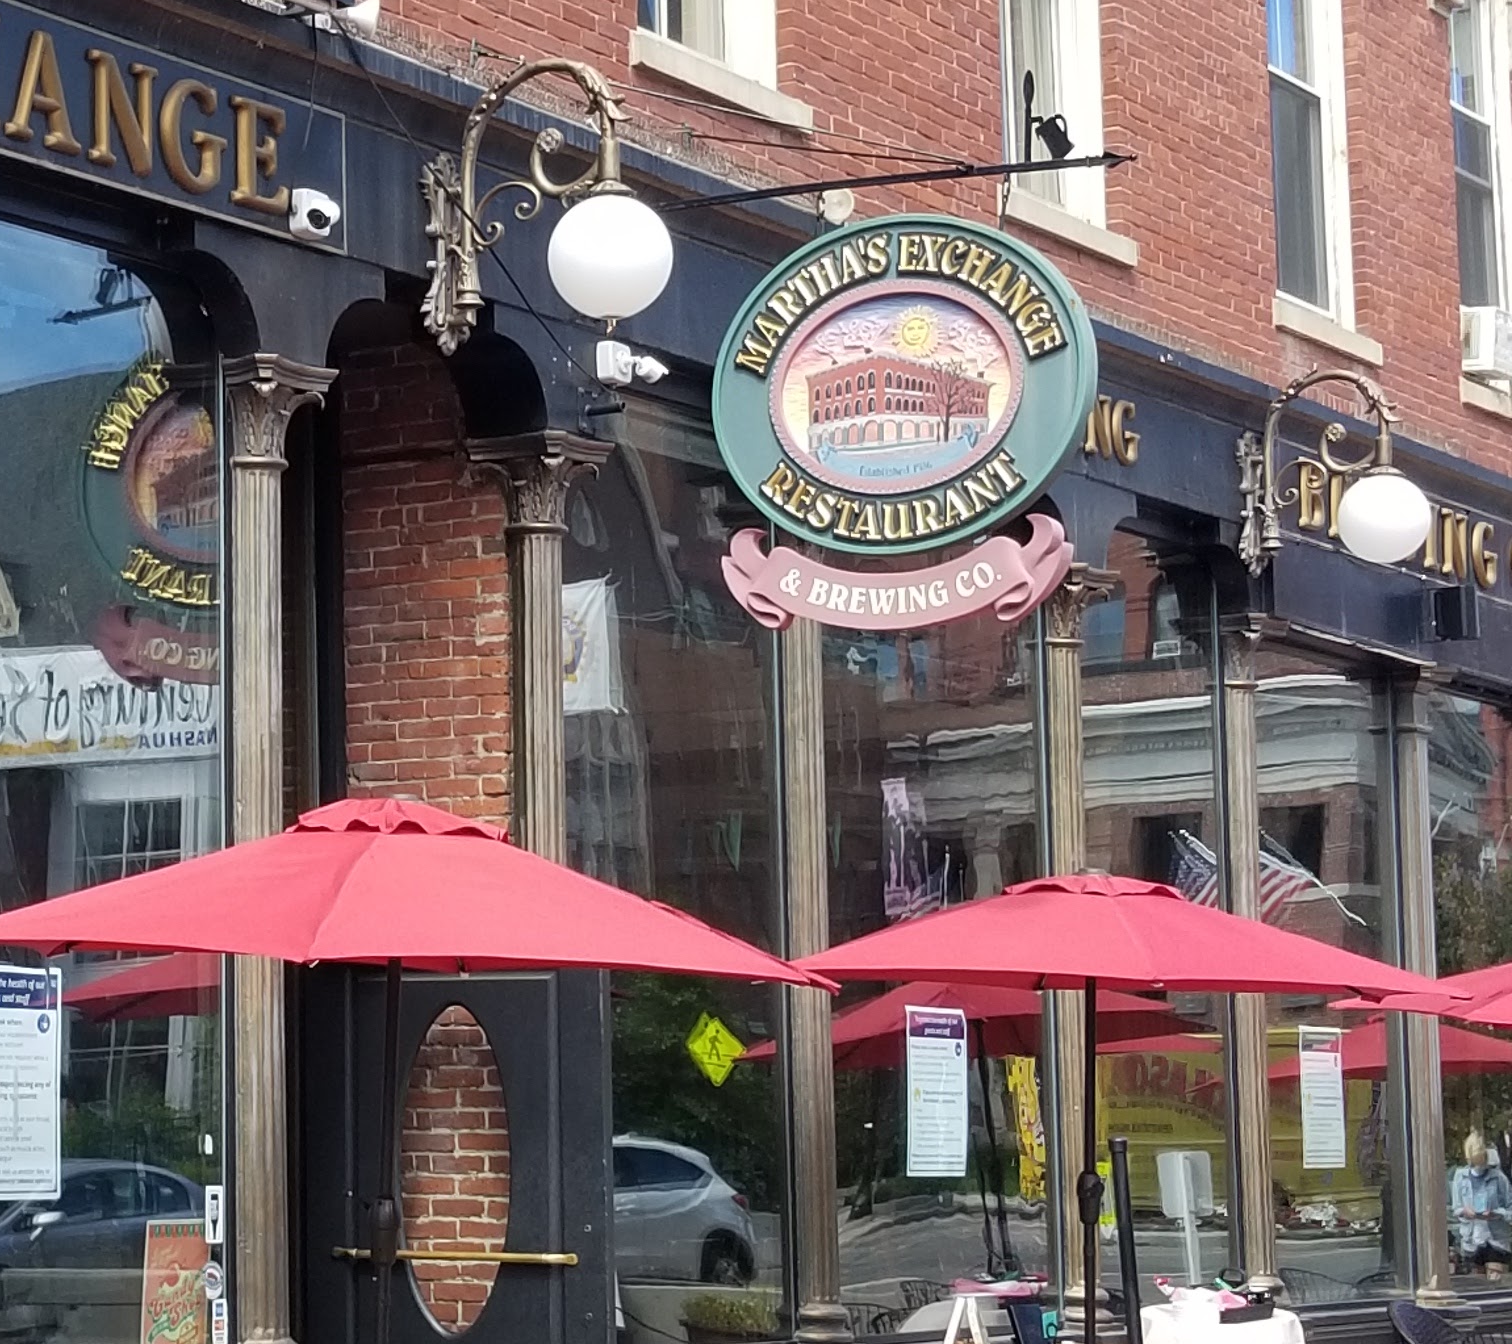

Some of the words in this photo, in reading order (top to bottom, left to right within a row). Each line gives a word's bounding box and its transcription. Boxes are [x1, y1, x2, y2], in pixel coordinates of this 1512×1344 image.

[735, 232, 892, 377] MARTHA'S
[897, 232, 1068, 359] EXCHANGE
[761, 451, 1026, 542] RESTAURANT
[779, 569, 801, 597] &
[806, 578, 949, 616] BREWING
[954, 562, 1003, 592] CO.
